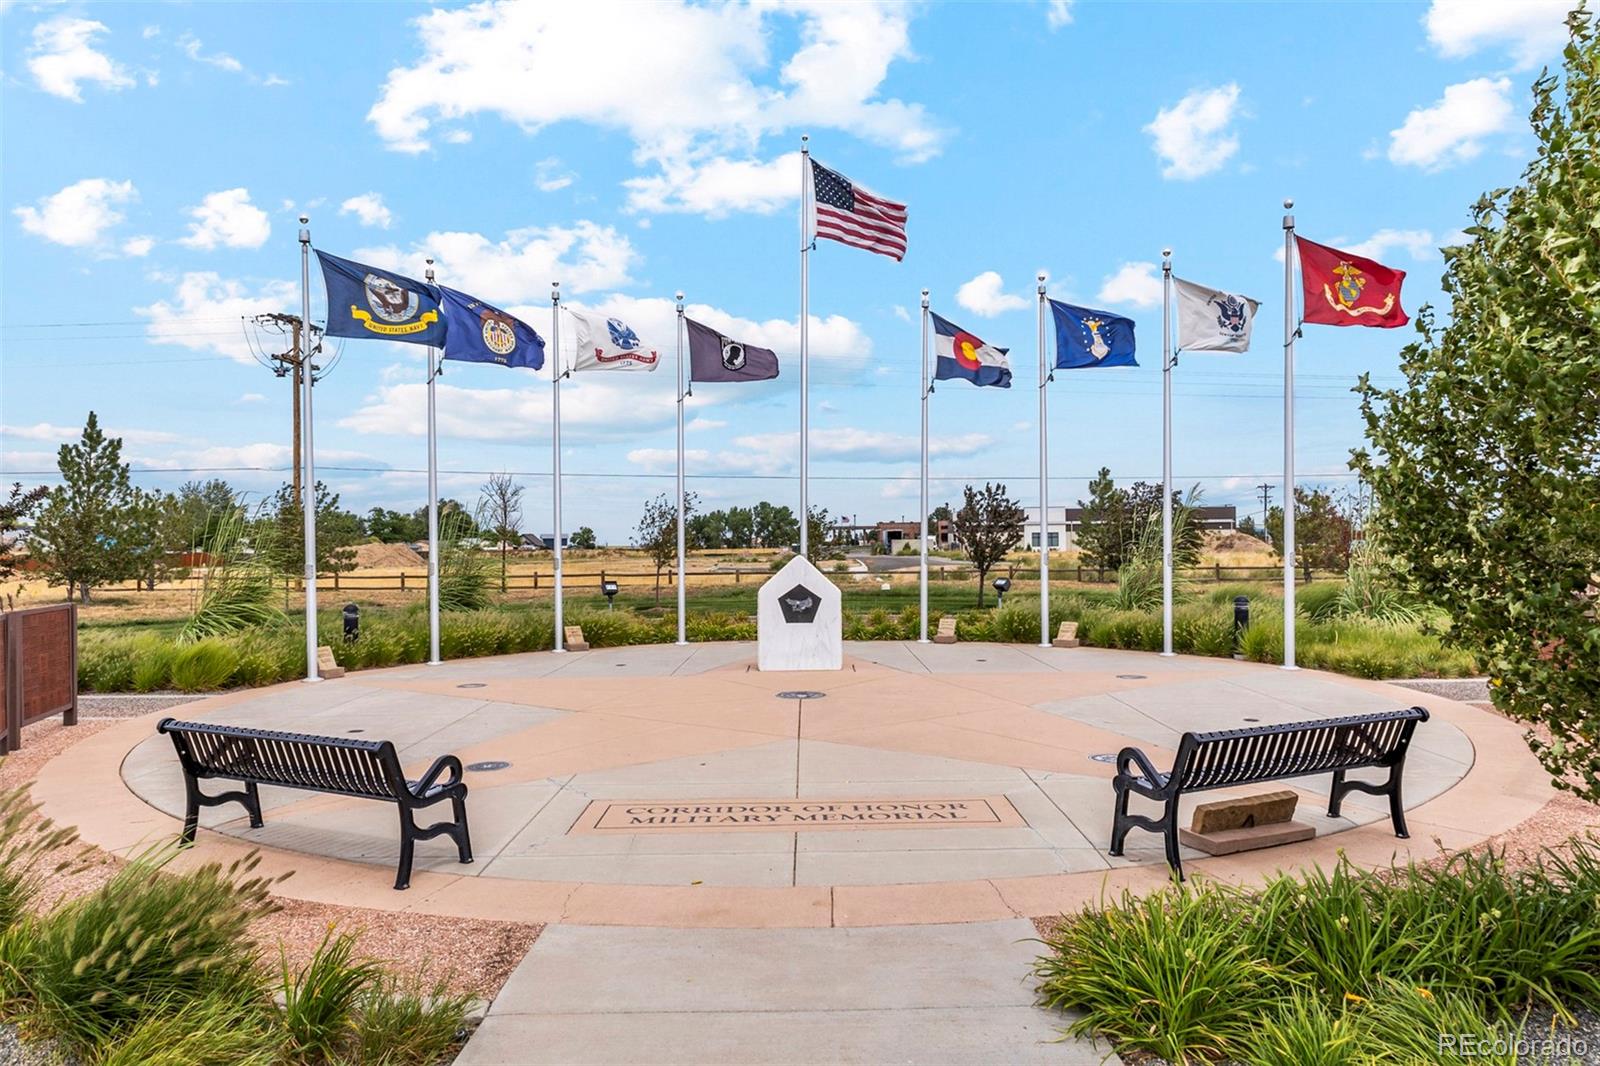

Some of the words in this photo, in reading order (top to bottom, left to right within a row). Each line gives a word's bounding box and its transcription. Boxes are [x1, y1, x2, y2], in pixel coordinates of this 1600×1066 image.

[409, 323, 424, 332] NAVY
[625, 805, 793, 815] CORRIDOR
[802, 804, 841, 812] OF
[853, 803, 969, 812] HONOR
[629, 814, 782, 824] MILITARY
[793, 812, 968, 822] MEMORIAL
